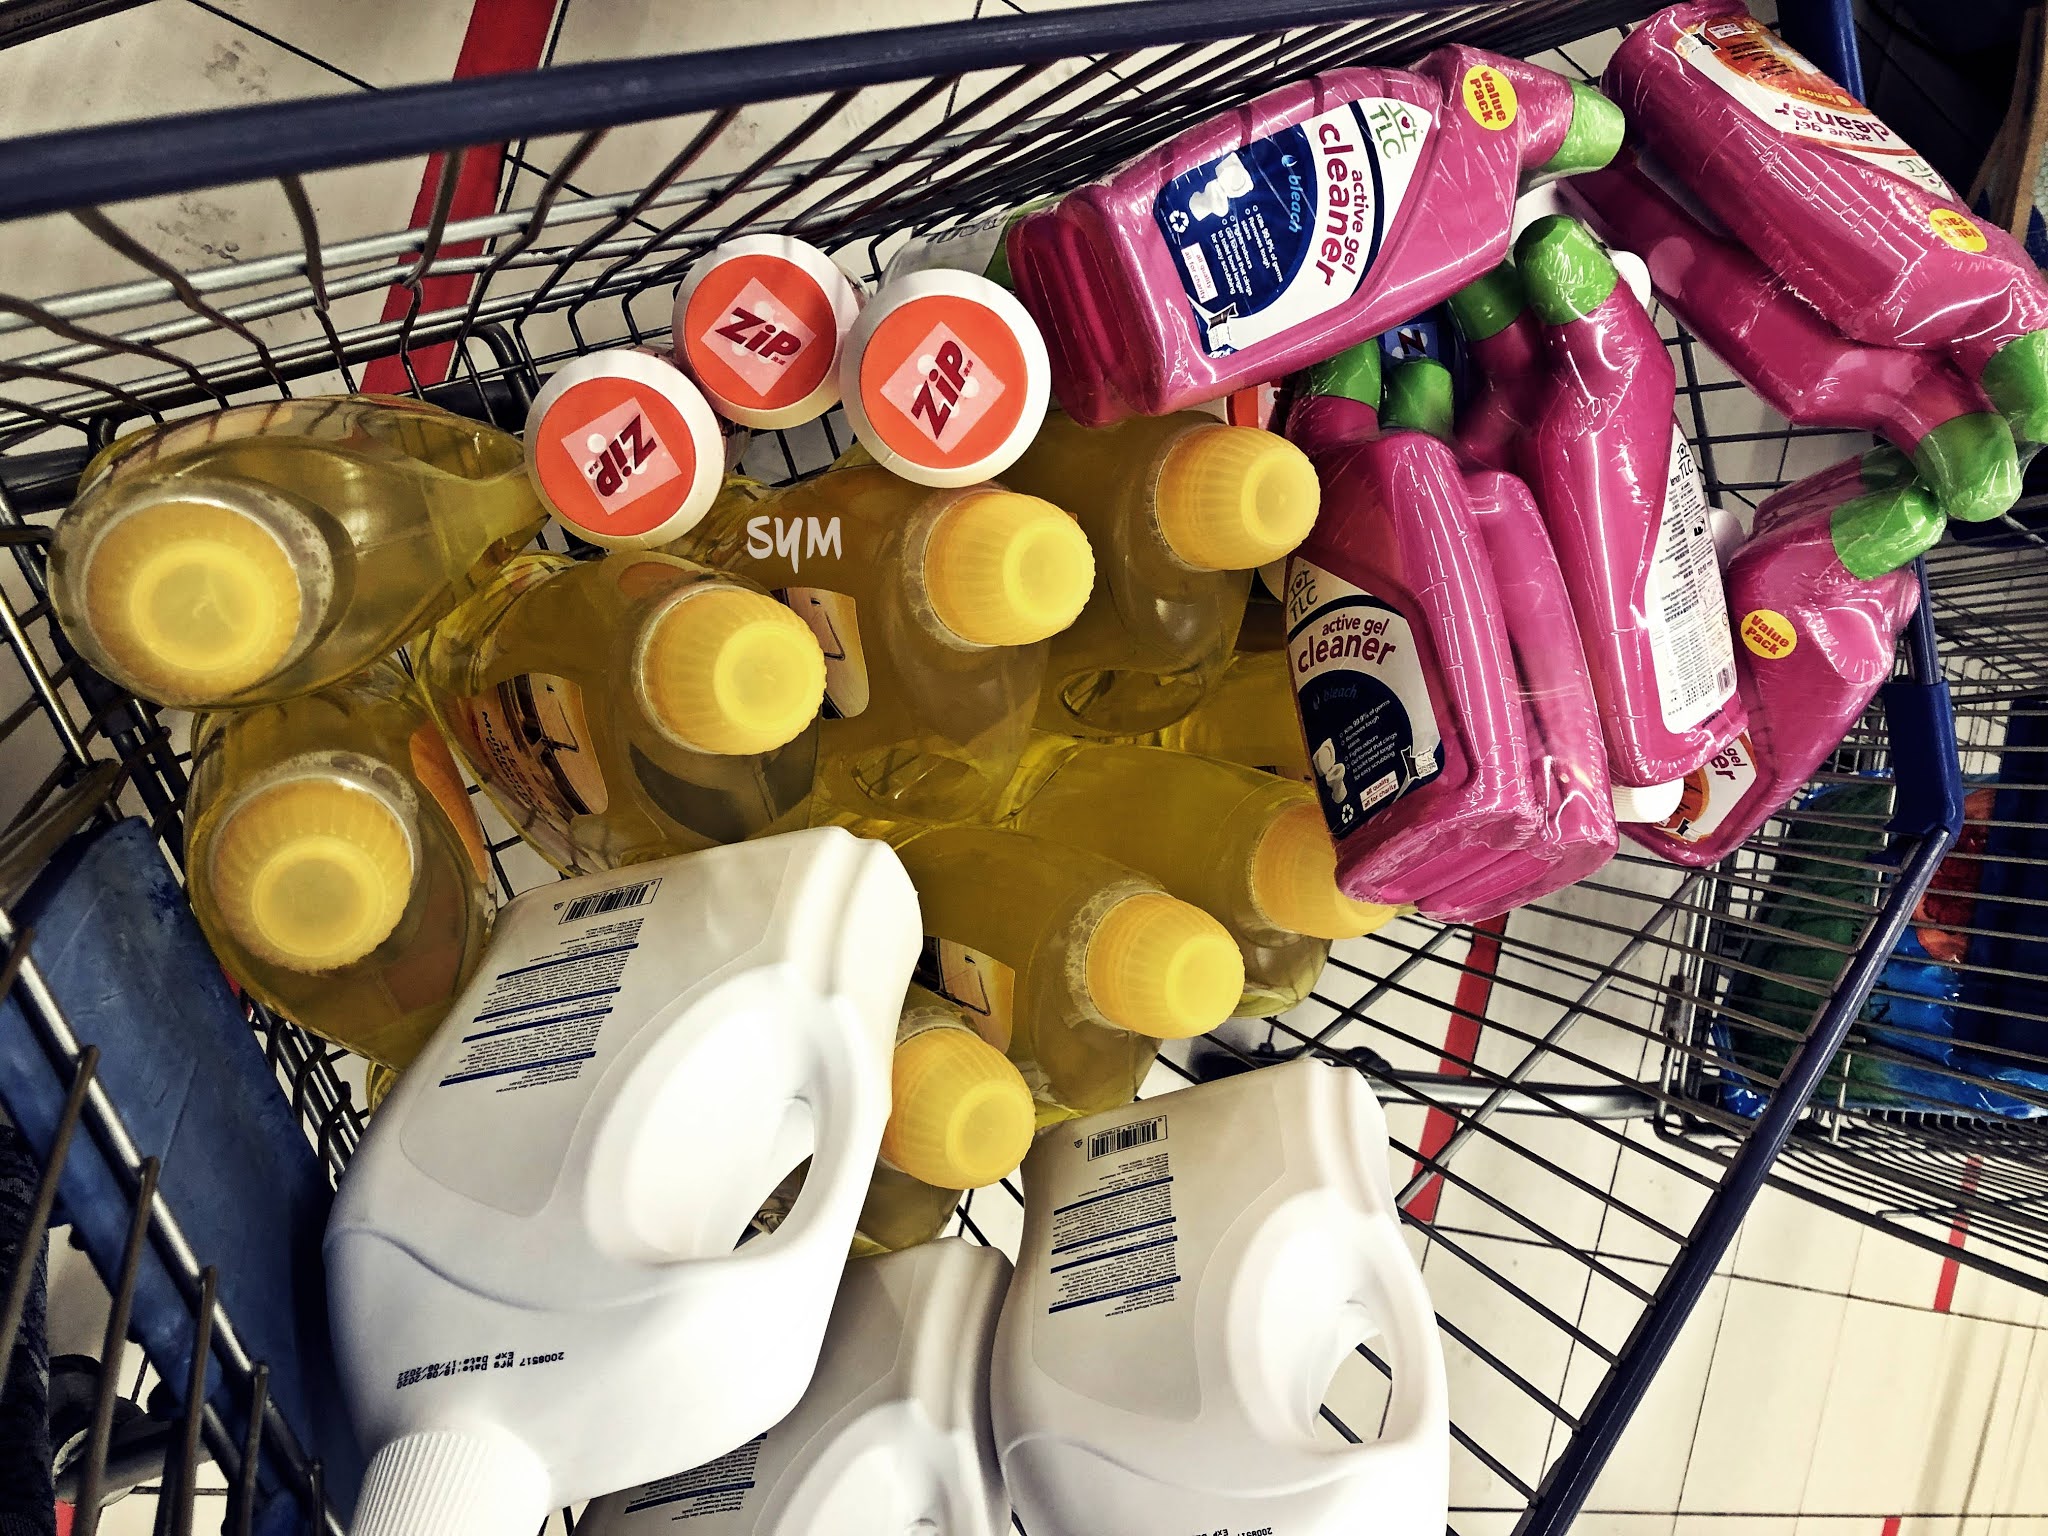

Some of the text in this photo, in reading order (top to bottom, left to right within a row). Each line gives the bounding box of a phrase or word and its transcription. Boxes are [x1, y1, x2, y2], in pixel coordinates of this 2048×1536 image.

[1470, 78, 1493, 123] Pack
[1481, 70, 1506, 121] Value
[1798, 87, 1836, 102] lemon
[1370, 104, 1403, 159] TLC
[1774, 101, 1891, 142] cleaner
[1829, 123, 1874, 142] active
[1288, 174, 1303, 234] bleach
[1317, 122, 1346, 287] cleaner
[1343, 169, 1370, 276] active gel
[1184, 250, 1206, 299] all for charity
[1199, 263, 1213, 289] quality
[1679, 459, 1694, 479] TLC
[1289, 590, 1319, 622] TLC
[1322, 614, 1390, 637] active gel
[1751, 614, 1790, 648] Value
[1297, 632, 1397, 674] cleaner
[1745, 626, 1779, 655] Pack
[1723, 748, 1747, 766] gel
[1362, 782, 1397, 808] all for charity
[1364, 776, 1390, 795] all quality
[493, 1359, 513, 1368] Mfg
[494, 1351, 514, 1360] Exp
[519, 1351, 564, 1366] 2008517
